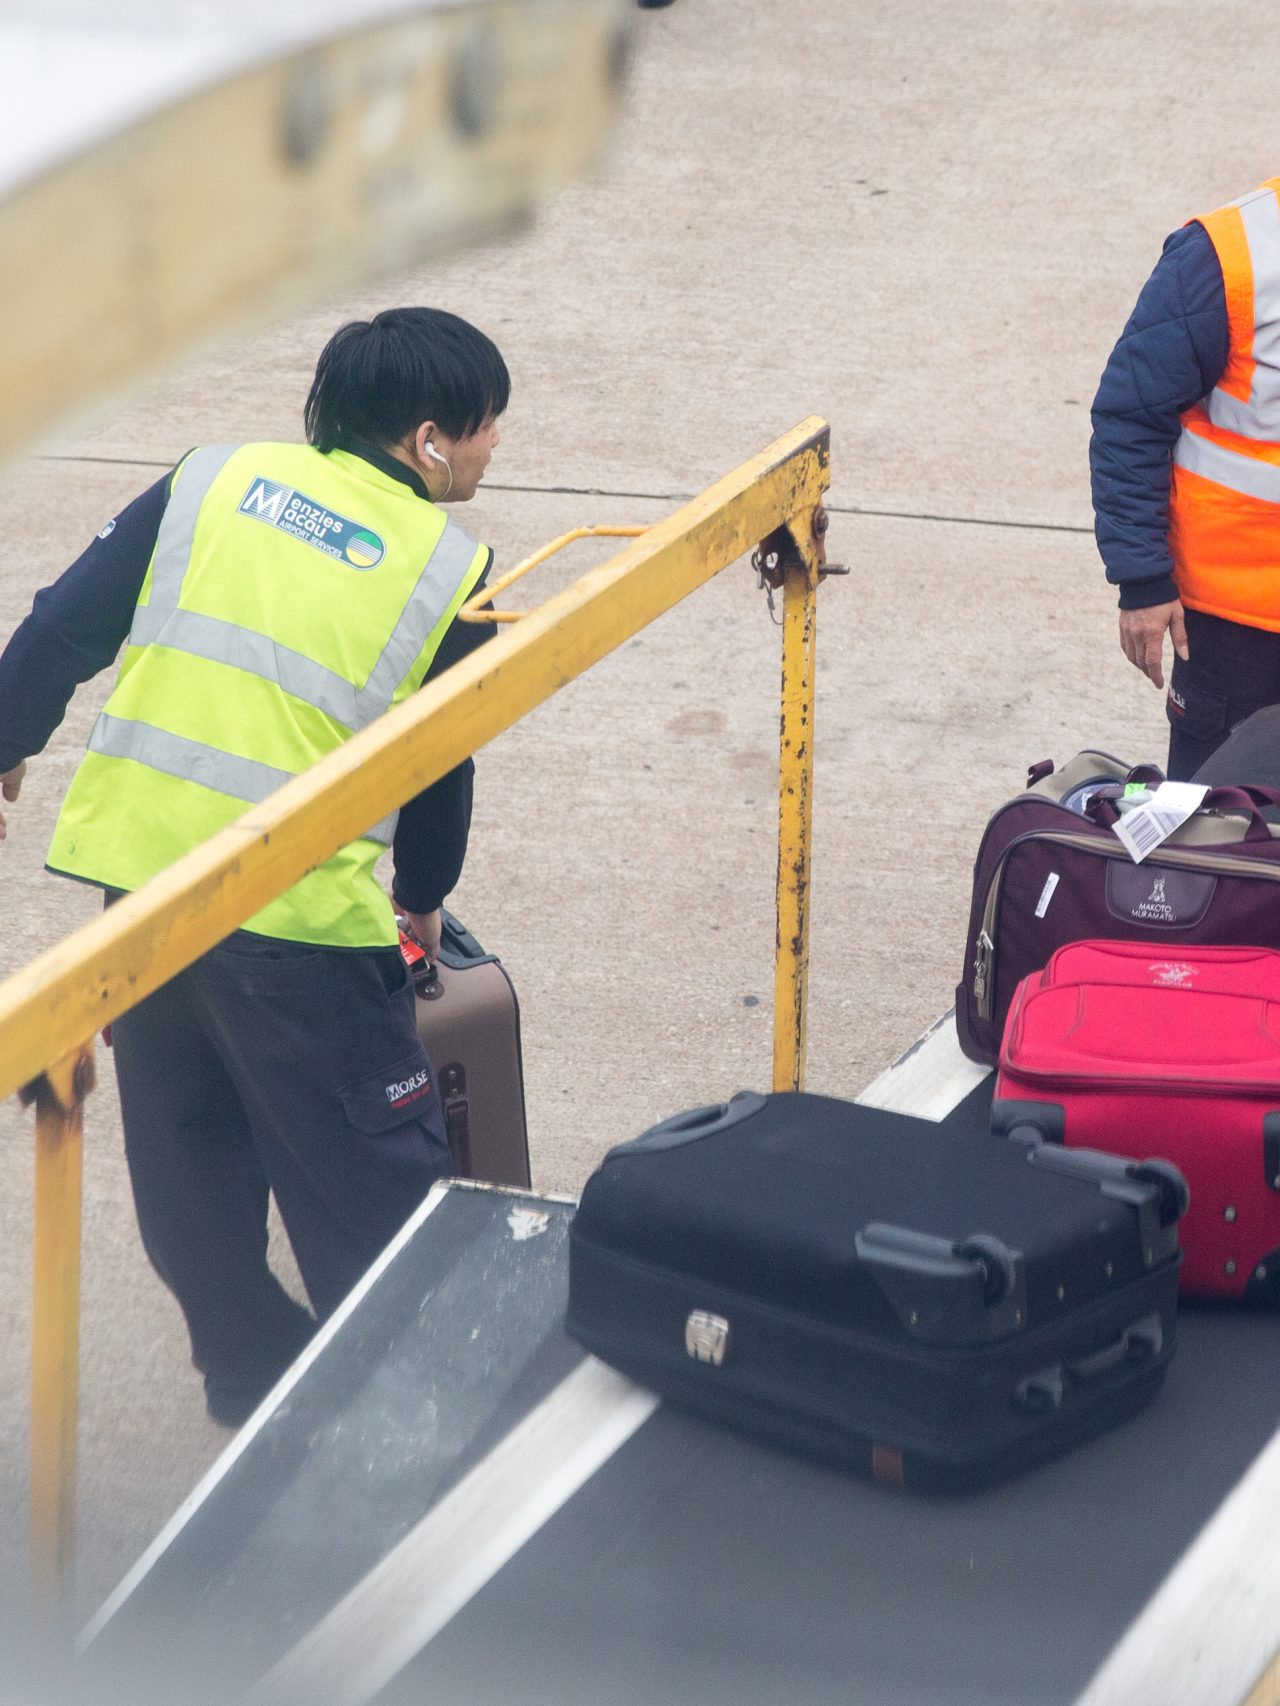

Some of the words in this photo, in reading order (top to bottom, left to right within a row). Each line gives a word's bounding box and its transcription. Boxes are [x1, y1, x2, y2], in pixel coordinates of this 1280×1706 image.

[279, 520, 310, 540] AIRPORT
[310, 535, 343, 558] SERVICES
[1139, 902, 1172, 913] MAKOTO
[385, 1069, 428, 1102] MORSE
